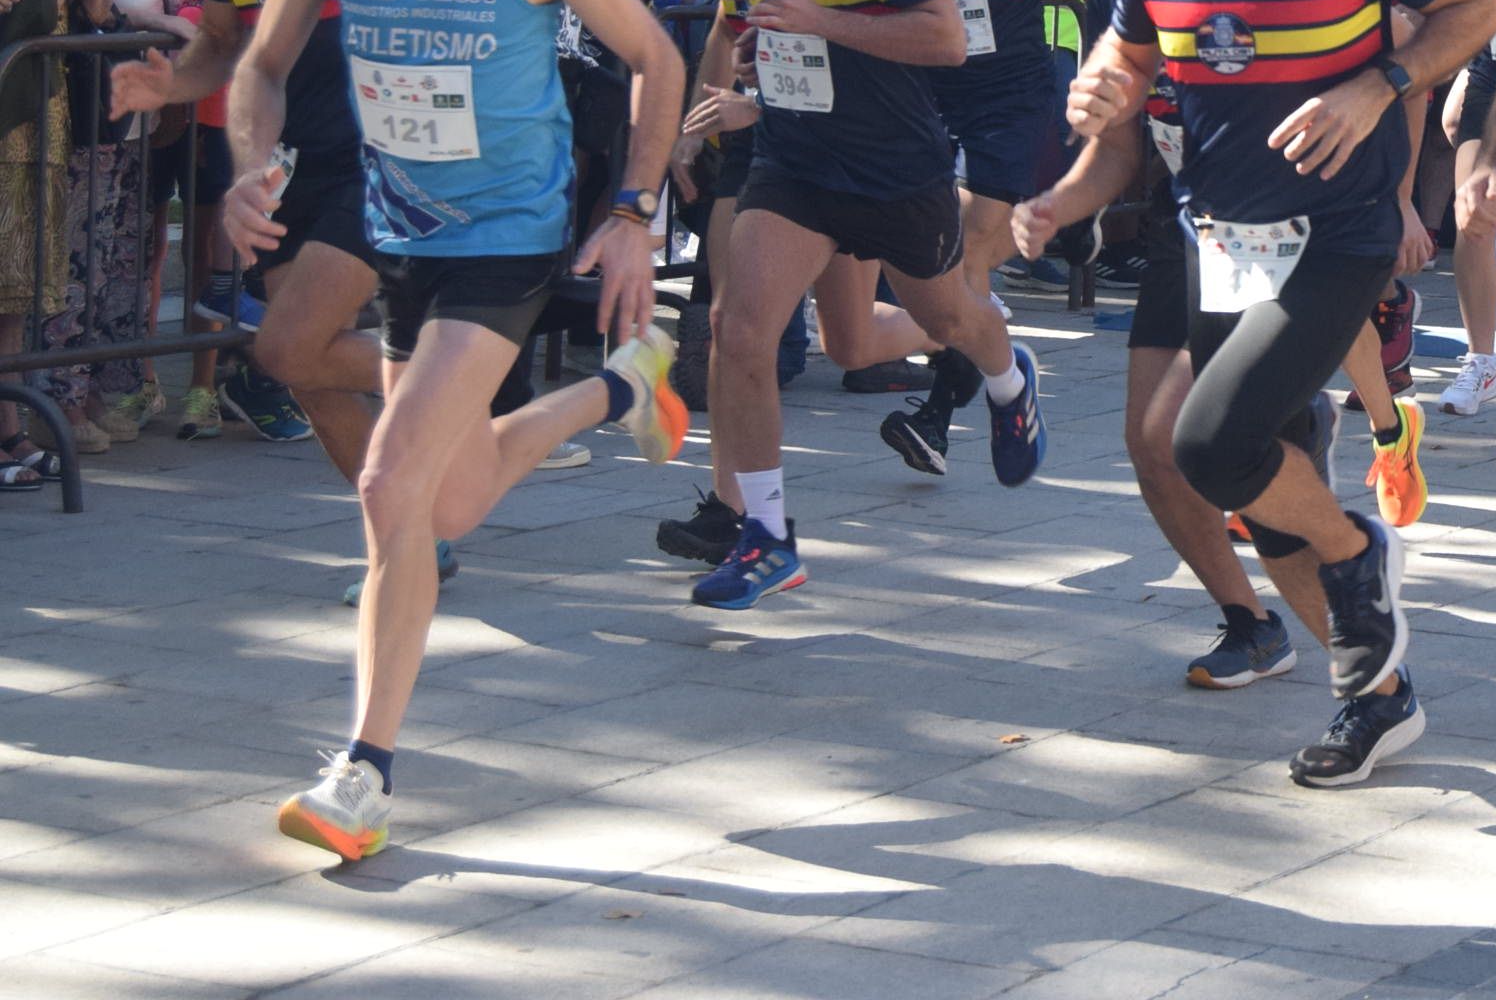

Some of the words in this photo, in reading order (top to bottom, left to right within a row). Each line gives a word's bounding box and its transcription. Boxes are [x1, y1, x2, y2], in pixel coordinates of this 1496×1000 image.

[347, 22, 497, 61] ATLETISMO
[773, 72, 812, 97] 394
[383, 114, 439, 145] 121
